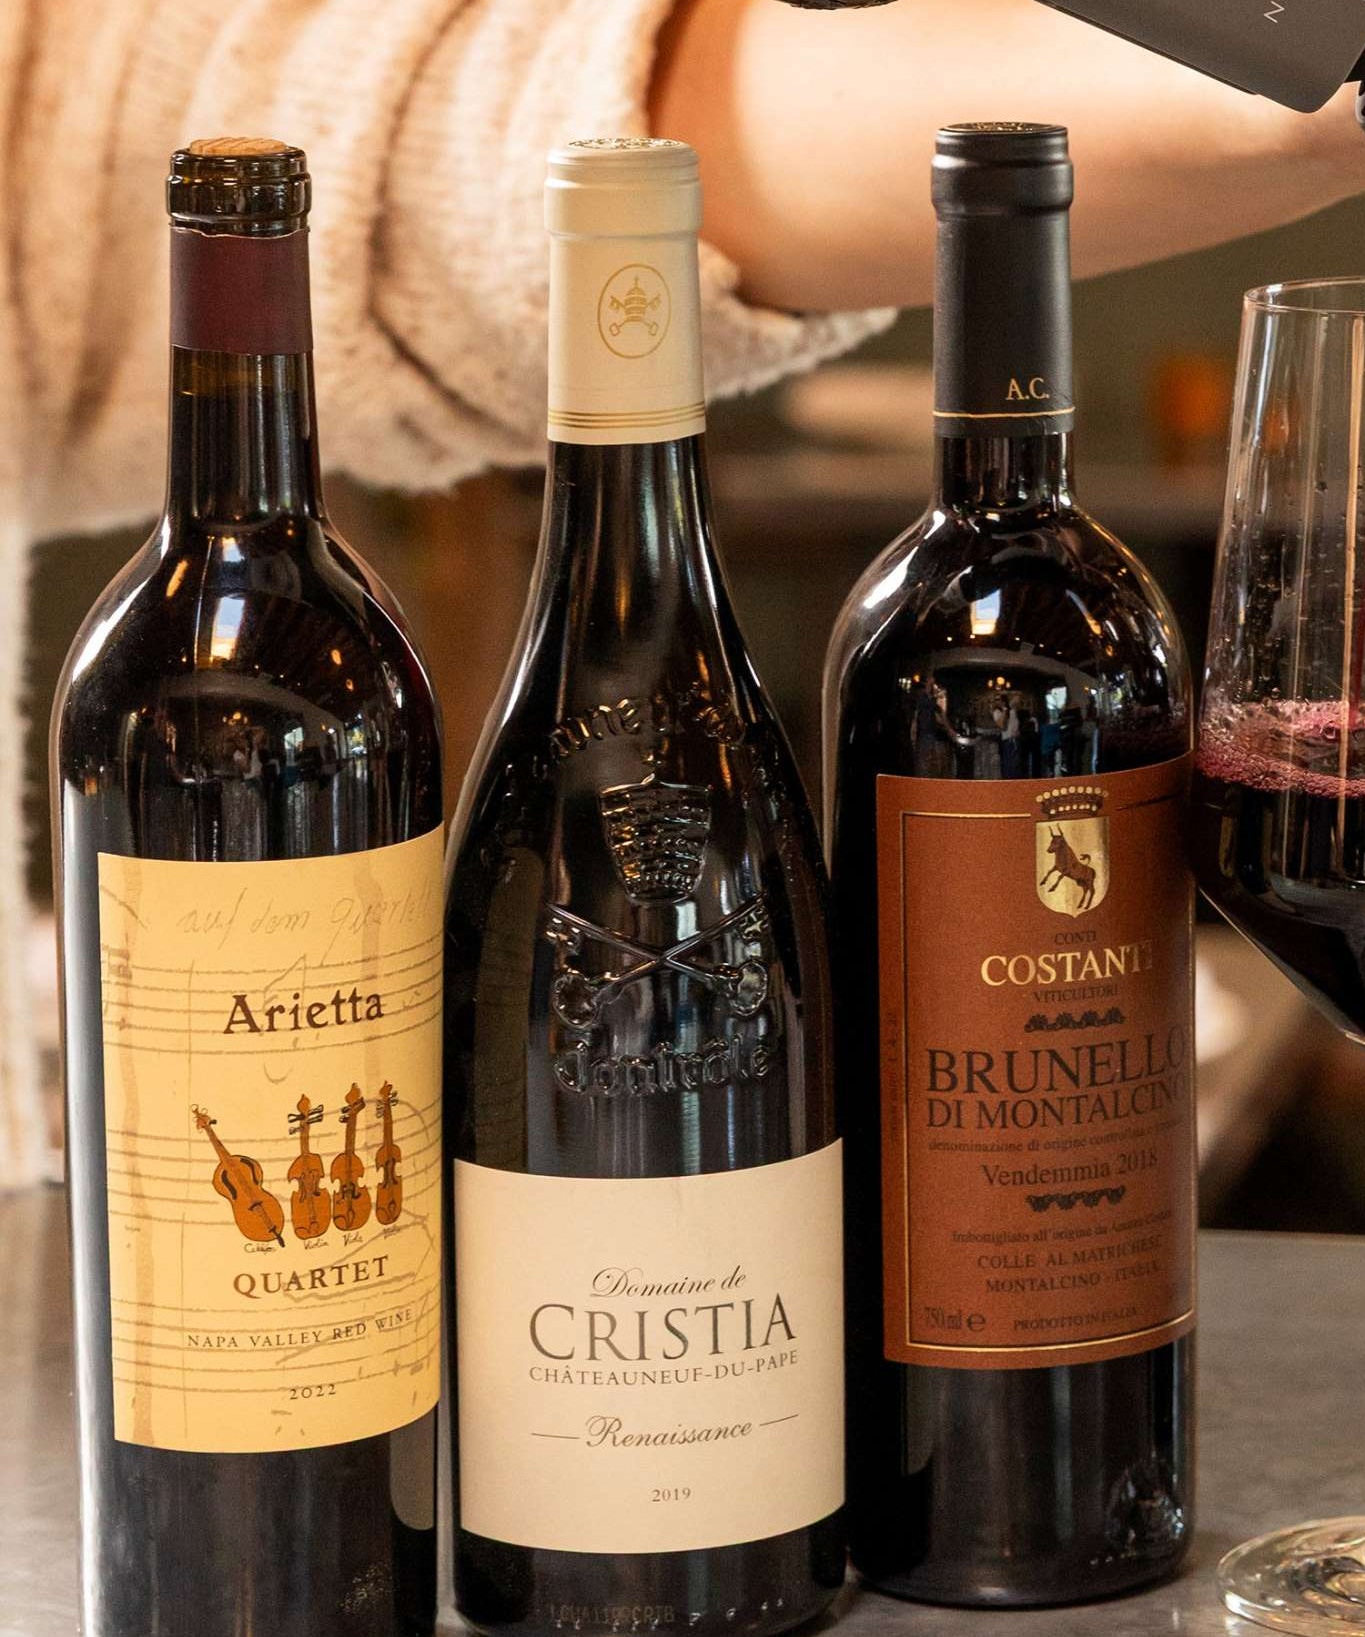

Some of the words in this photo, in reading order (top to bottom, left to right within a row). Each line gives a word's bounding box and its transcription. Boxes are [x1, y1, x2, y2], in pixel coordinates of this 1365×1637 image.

[1005, 376, 1050, 401] A.C.
[223, 986, 385, 1034] Arietta
[927, 1024, 1186, 1095] BRUNELLO
[925, 1097, 962, 1129] DI
[981, 1158, 1111, 1187] Vendemmia
[233, 1254, 390, 1300] QUARTET
[588, 1266, 717, 1298] Domaine
[721, 1264, 747, 1290] de
[187, 1334, 239, 1349] NAPA
[249, 1330, 323, 1348] VALLEY
[332, 1322, 368, 1341] RED
[374, 1308, 414, 1331] WINE
[528, 1292, 798, 1361] CRISTIA
[528, 1348, 799, 1387] CHÂTEAUNEUF-DU-PAPE
[288, 1383, 337, 1401] 2022
[585, 1414, 753, 1448] Renaissance
[651, 1486, 692, 1503] 2019
